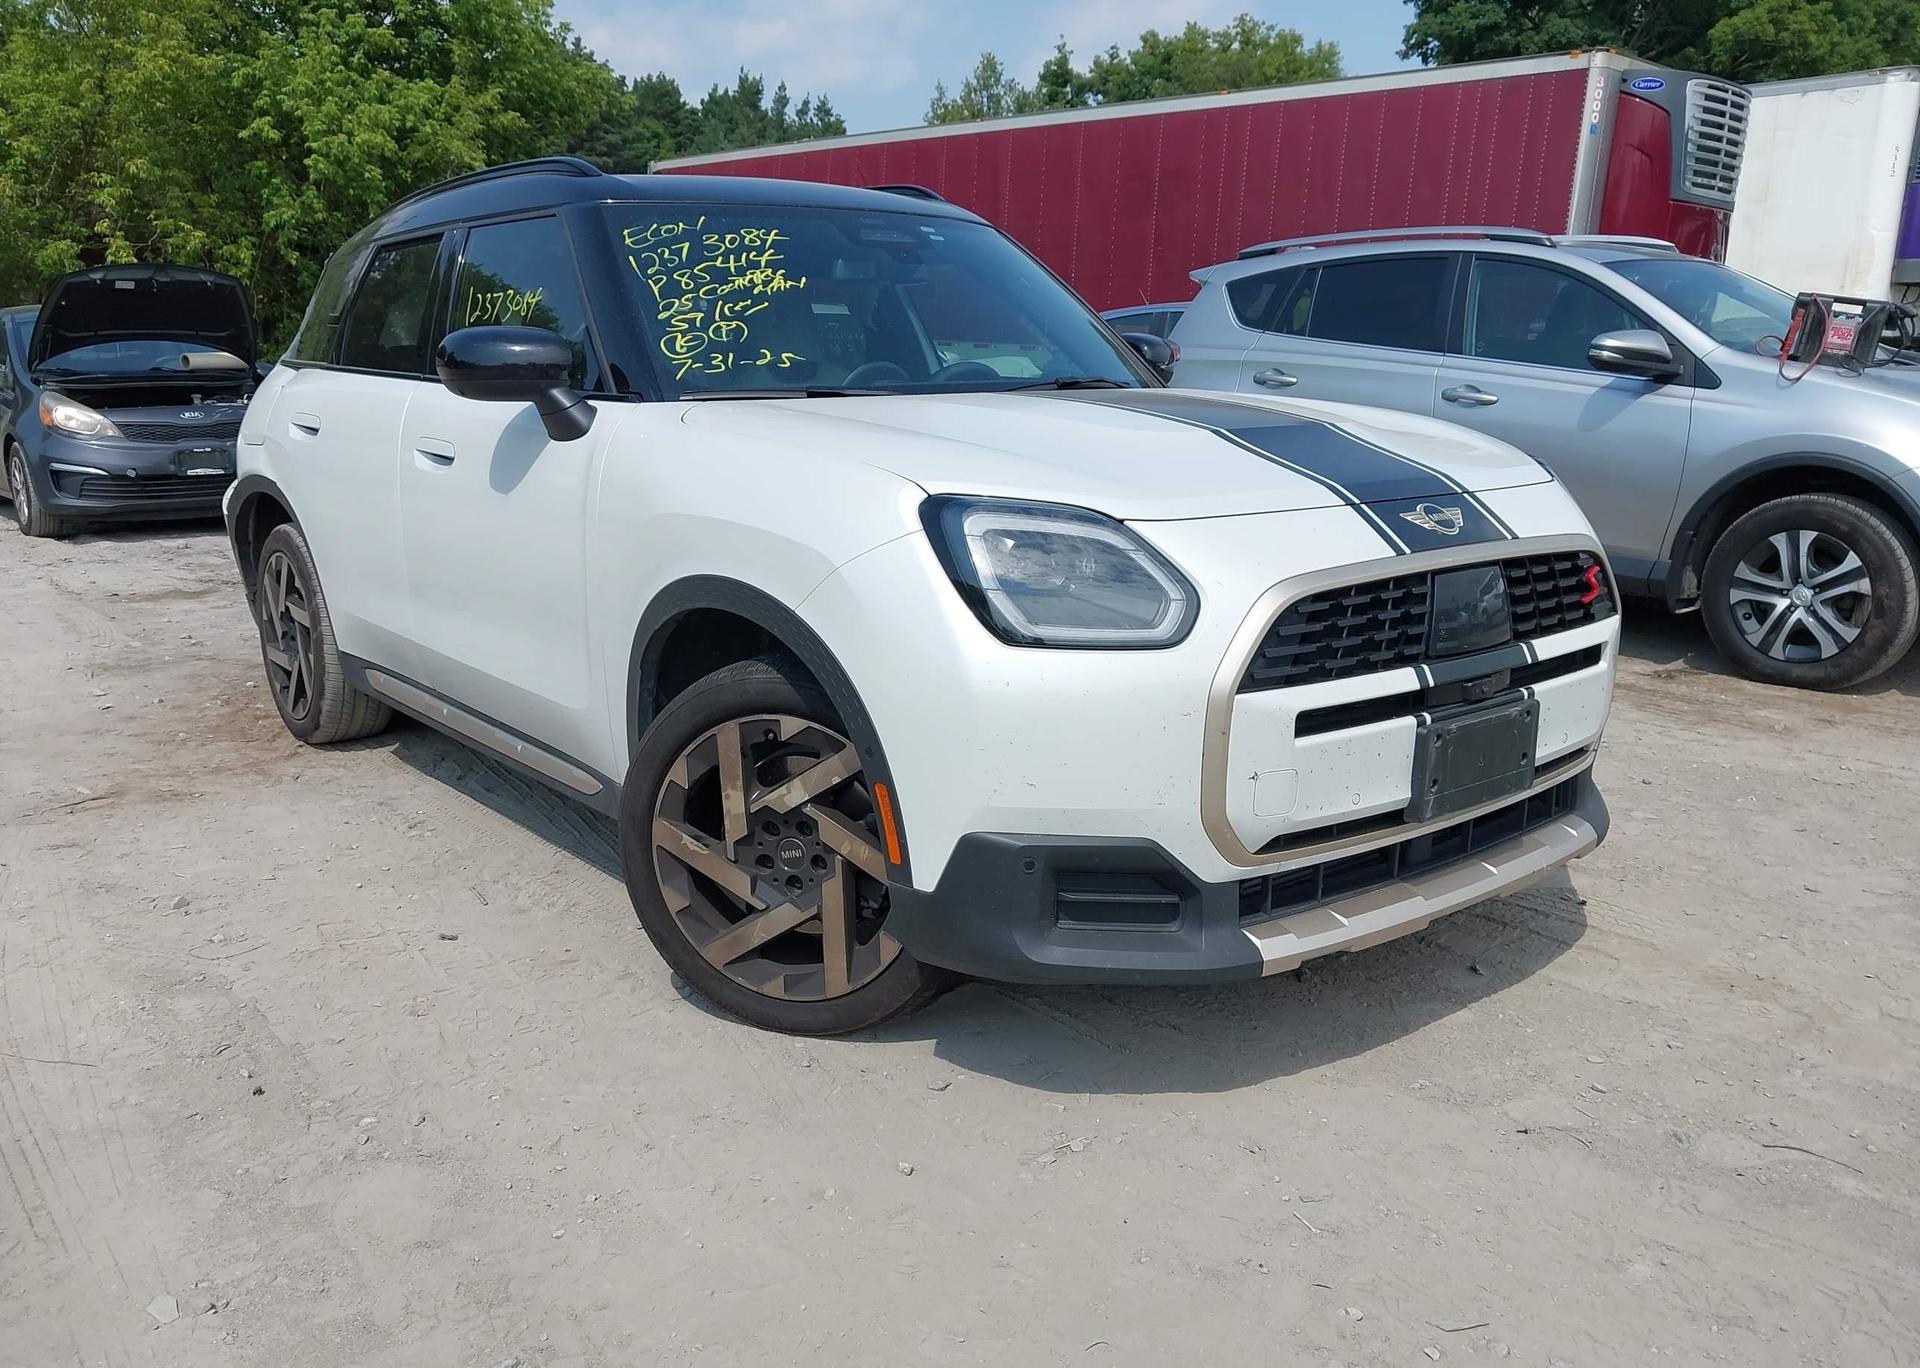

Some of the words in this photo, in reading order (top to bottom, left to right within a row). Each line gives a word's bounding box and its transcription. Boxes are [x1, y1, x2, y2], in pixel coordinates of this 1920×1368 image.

[1635, 80, 1661, 88] Carrier
[466, 287, 543, 327] 12373084
[781, 849, 802, 859] MINI
